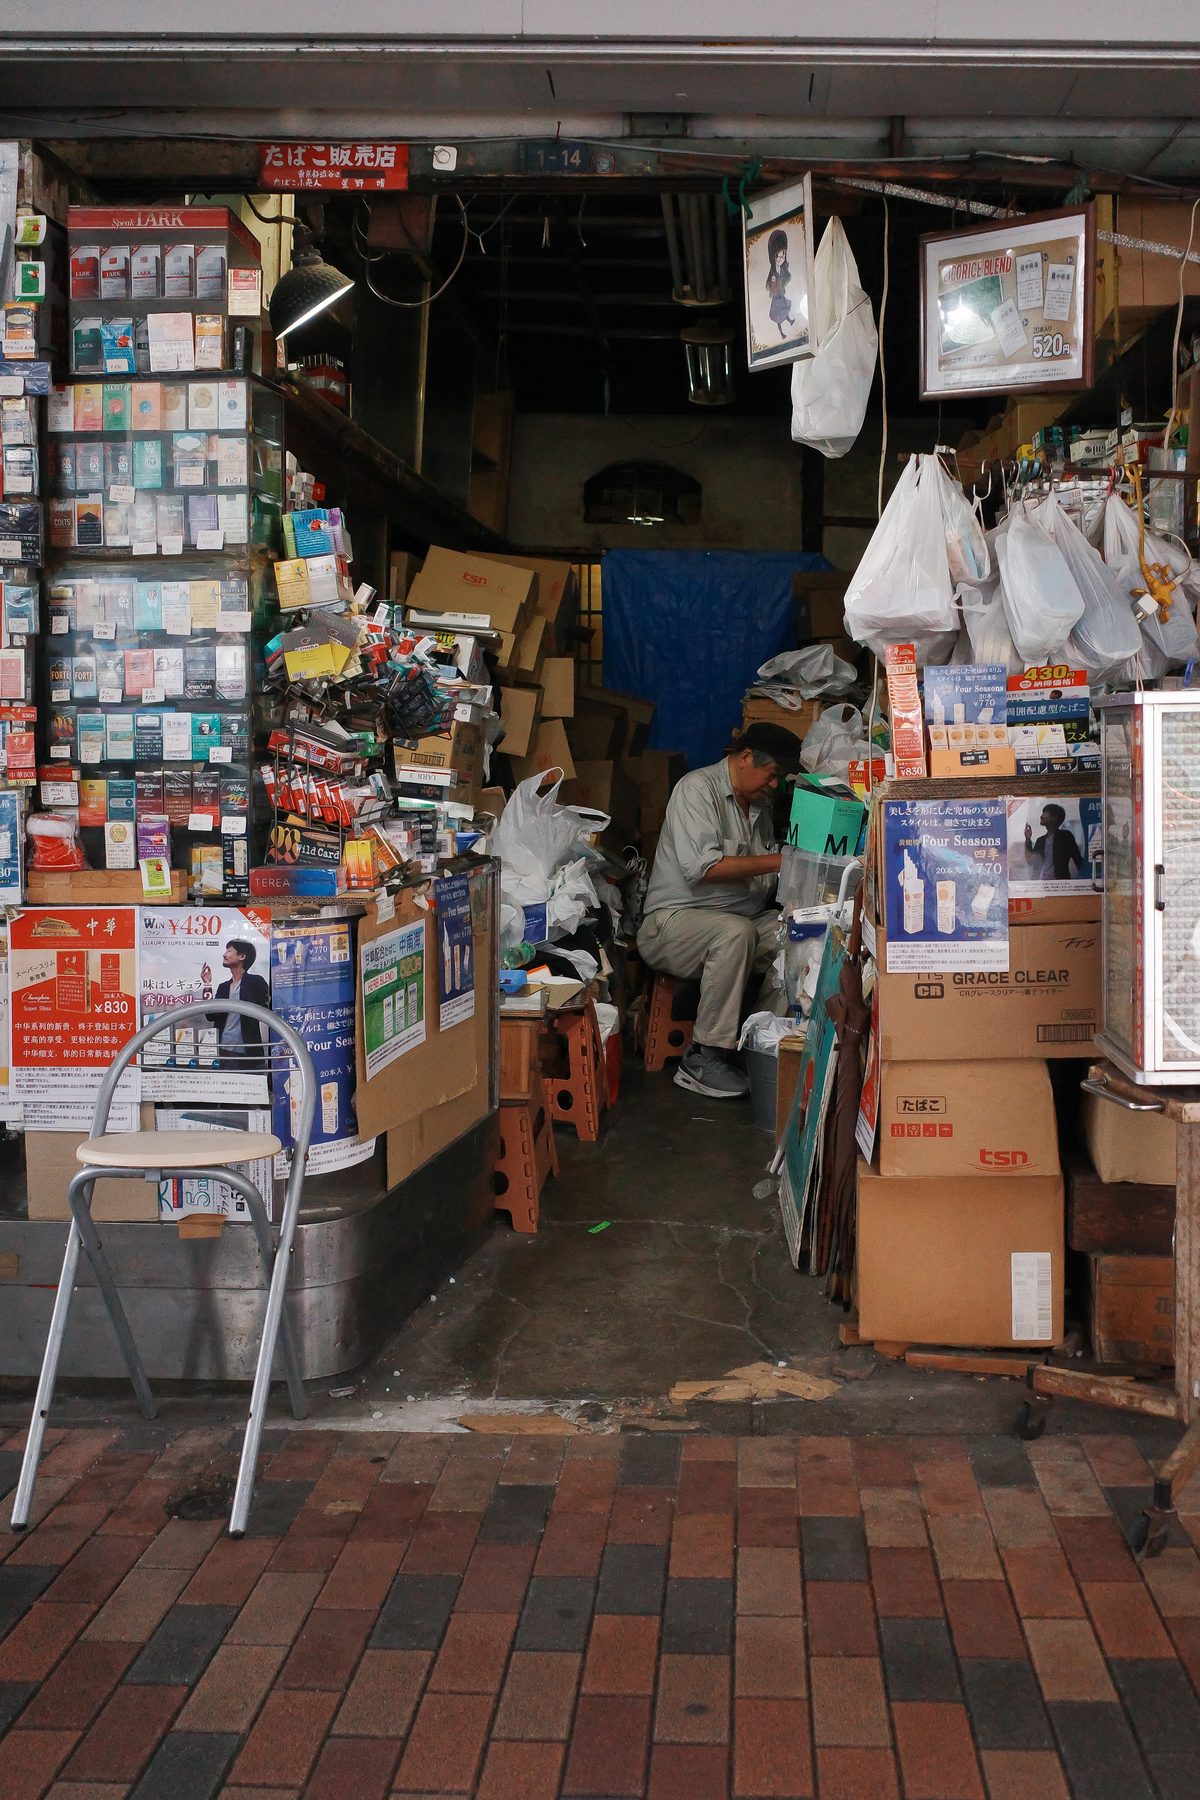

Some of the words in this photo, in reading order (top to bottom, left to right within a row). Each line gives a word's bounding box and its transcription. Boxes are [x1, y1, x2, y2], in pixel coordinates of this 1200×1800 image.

[265, 145, 397, 167] たばこ販売店
[136, 212, 185, 227] LARK
[984, 256, 1012, 276] BLEND
[1032, 333, 1070, 359] 520円
[54, 518, 72, 527] COLTS
[463, 571, 488, 585] tsn
[51, 671, 70, 681] FORTE
[74, 671, 93, 681] FORTE
[1024, 665, 1075, 681] 430円
[889, 806, 1002, 816] 美しさを形にした究極のスリム
[824, 833, 848, 856] M
[922, 835, 949, 846] Four
[954, 834, 1001, 846] Seasons
[318, 848, 340, 860] Card
[974, 847, 999, 860] 四季
[255, 878, 291, 888] TEREA
[86, 916, 117, 936] 中華
[168, 914, 222, 936] ¥430
[15, 960, 56, 978] スーパースリム
[952, 970, 1010, 985] GRACE
[1014, 969, 1070, 984] CLEAR
[94, 1000, 129, 1014] ¥830
[307, 1040, 332, 1053] Four
[902, 1099, 941, 1112] たばこ
[979, 1148, 1028, 1166] tsn
